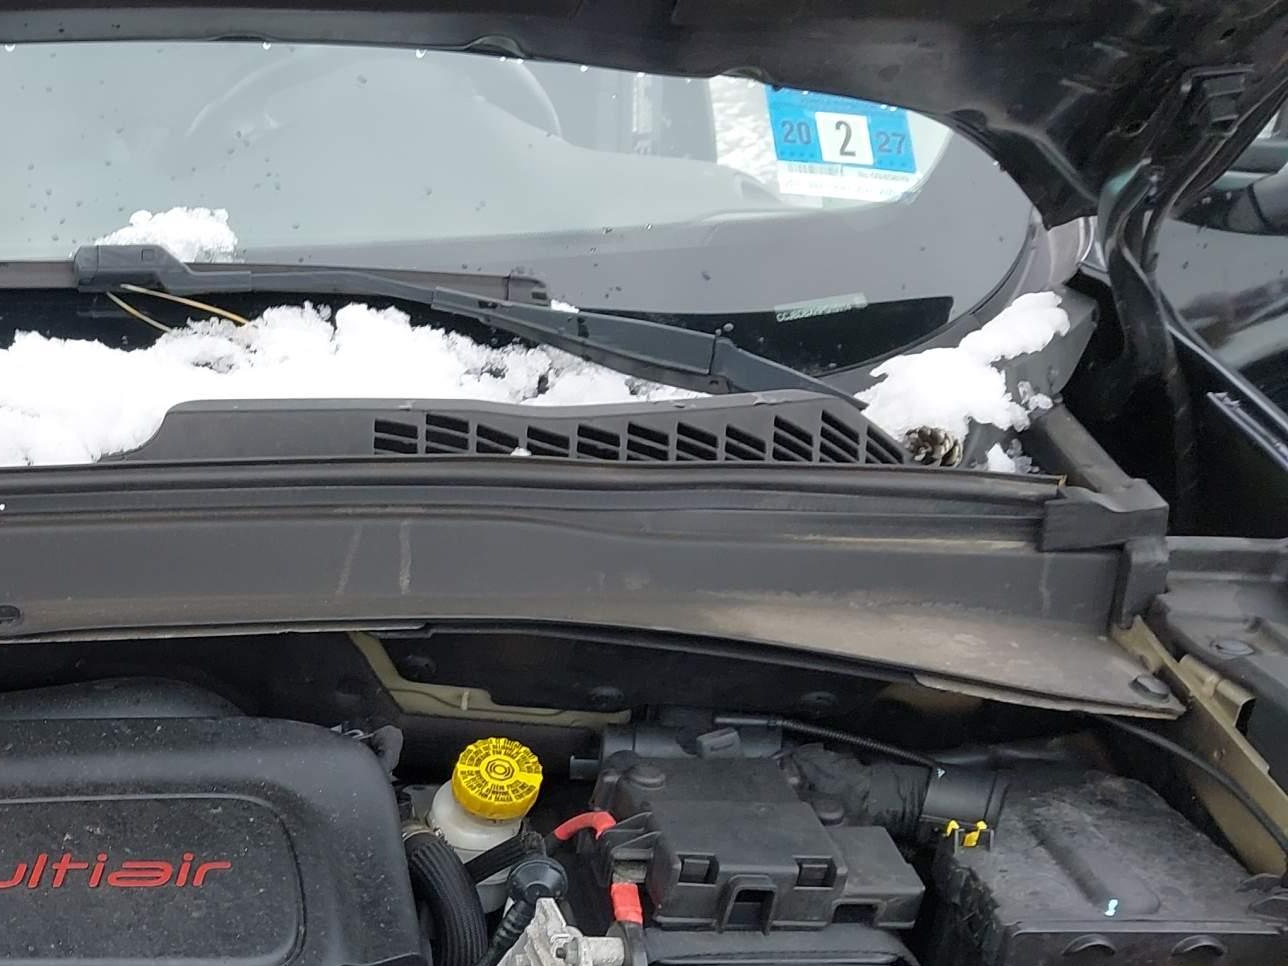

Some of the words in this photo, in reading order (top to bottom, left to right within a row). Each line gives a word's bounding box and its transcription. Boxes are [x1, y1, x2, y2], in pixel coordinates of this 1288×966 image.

[781, 120, 812, 145] 20
[835, 120, 856, 157] 2
[875, 131, 906, 155] 27
